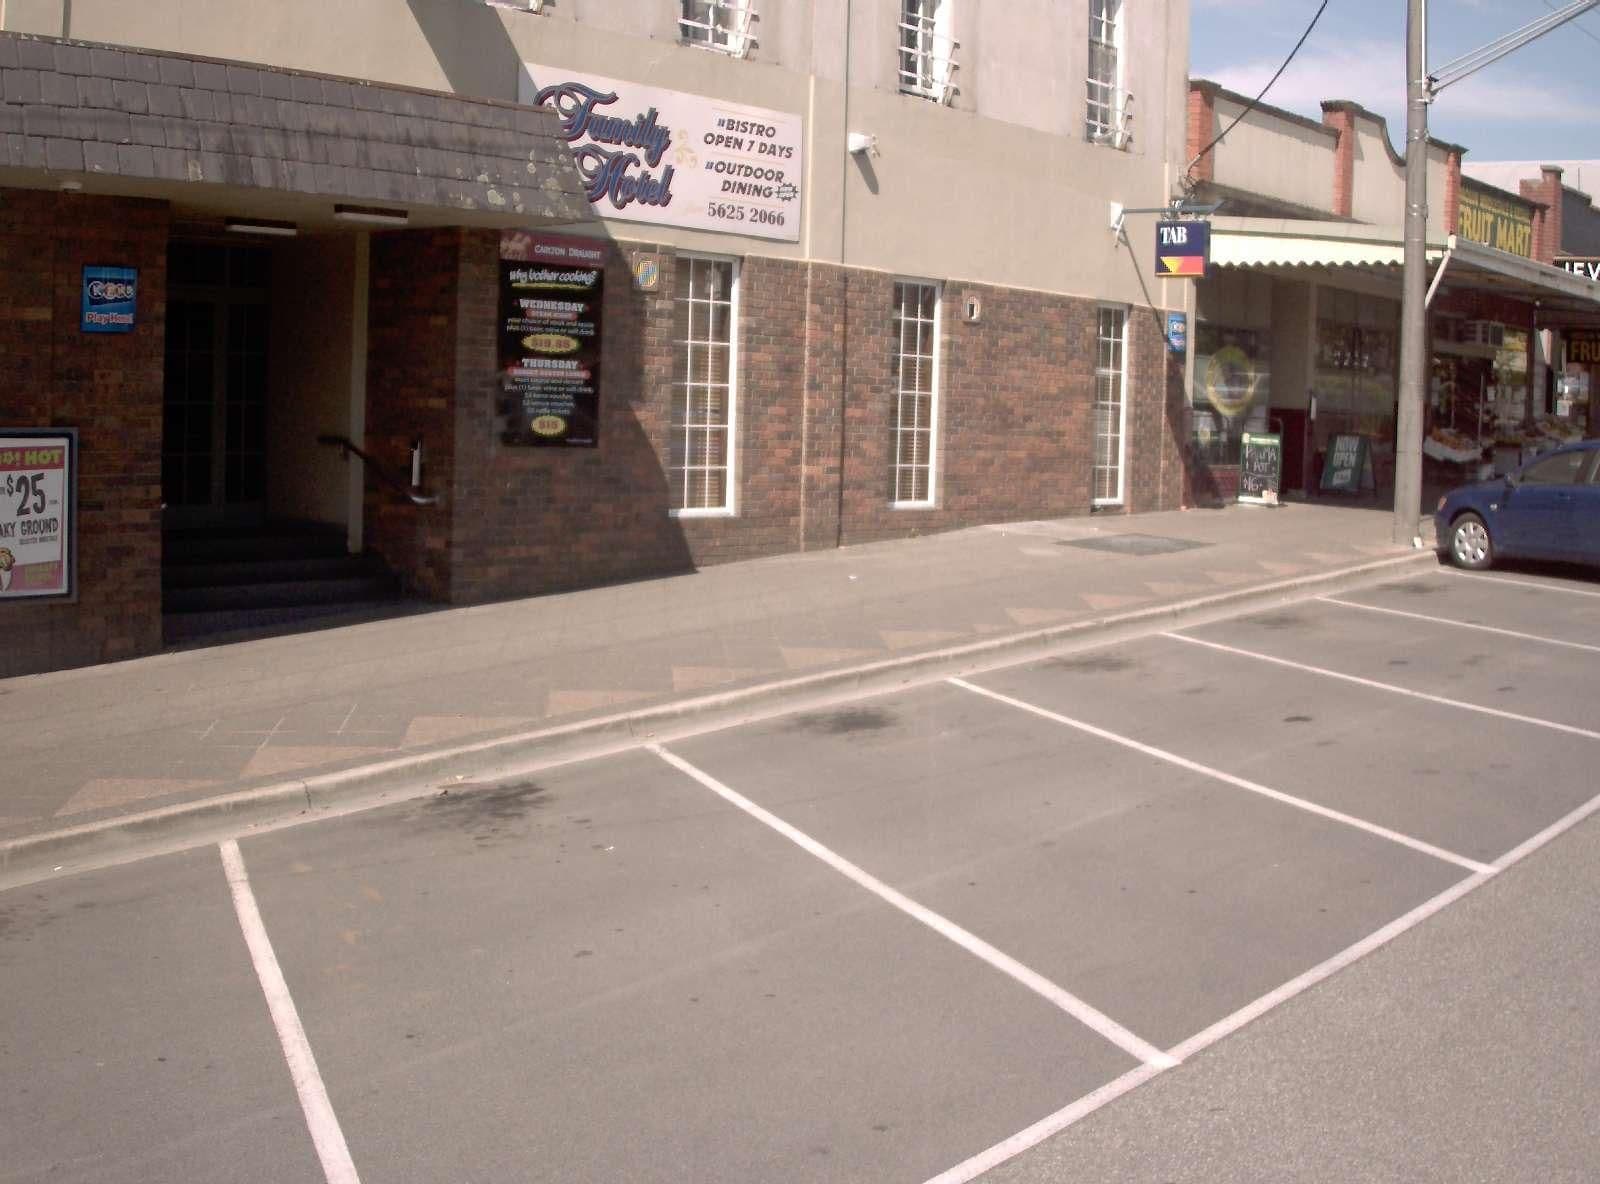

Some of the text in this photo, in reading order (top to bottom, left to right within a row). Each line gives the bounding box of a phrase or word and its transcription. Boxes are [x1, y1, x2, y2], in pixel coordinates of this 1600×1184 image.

[703, 132, 793, 159] OPEN 7 DAYS
[572, 143, 675, 211] Hotel
[721, 180, 773, 198] DINING
[707, 202, 785, 226] 5625 2066
[1160, 226, 1187, 244] TAB
[1458, 205, 1531, 257] FRUIT MART
[534, 244, 600, 259] CARLTON DRAUGHT
[519, 298, 584, 312] WEDNESDAY
[521, 358, 578, 370] THURSDAY
[25, 449, 63, 465] HOT
[7, 472, 45, 516] $25
[21, 517, 59, 536] GROUND
